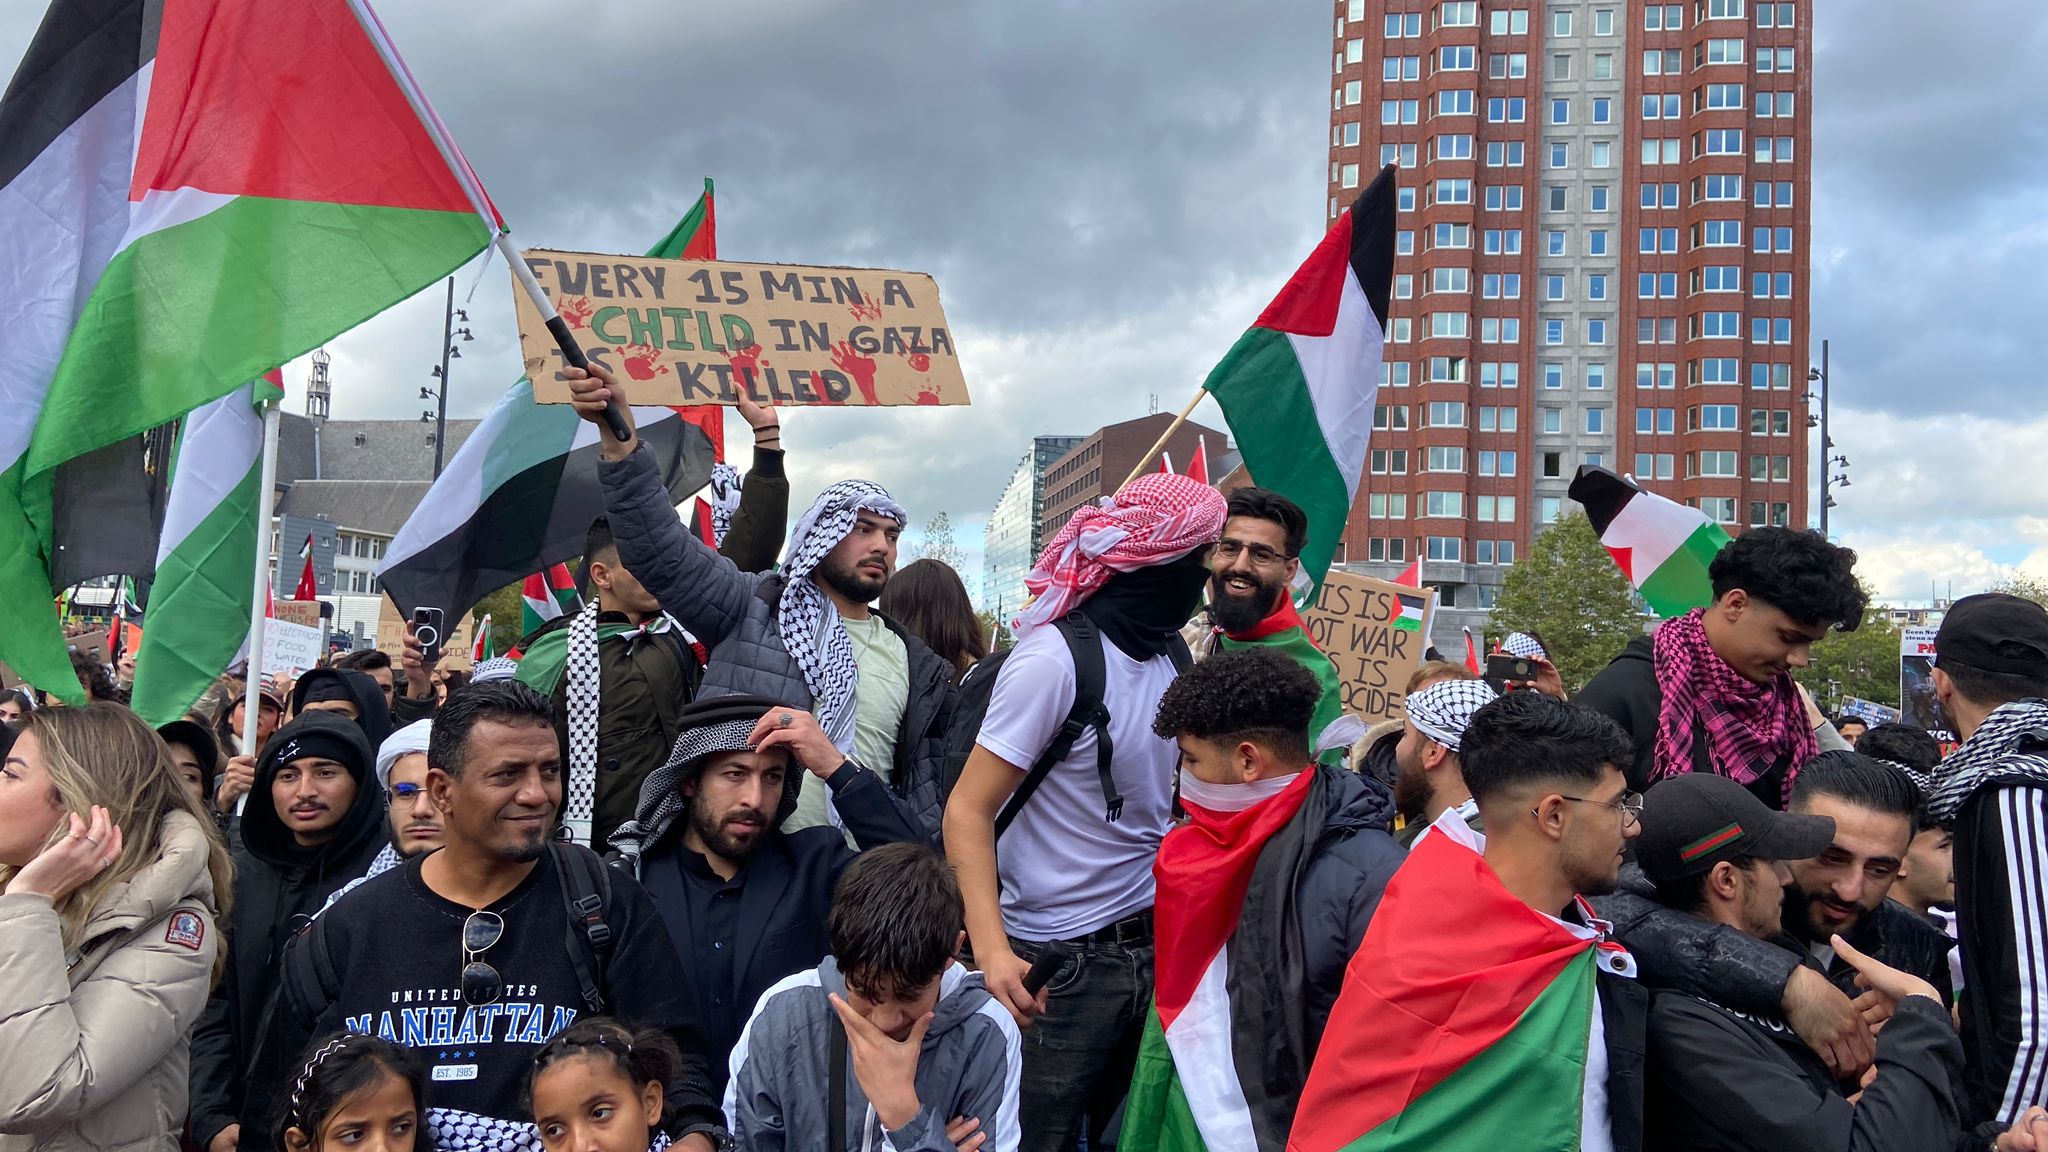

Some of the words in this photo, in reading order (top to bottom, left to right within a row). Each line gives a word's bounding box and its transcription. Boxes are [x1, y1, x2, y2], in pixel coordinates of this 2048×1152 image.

[523, 257, 666, 300] EVERY
[687, 269, 750, 305] 15
[758, 270, 865, 305] MIN
[882, 278, 916, 309] A
[590, 305, 755, 352] CHILD
[769, 318, 831, 351] IN
[848, 325, 954, 357] GAZA
[674, 360, 853, 402] KILLED
[1354, 589, 1390, 622] IS
[1350, 623, 1407, 660] WAR
[1353, 657, 1389, 688] IS
[391, 988, 461, 1003] UNITED
[345, 1003, 578, 1048] MANHATTAN
